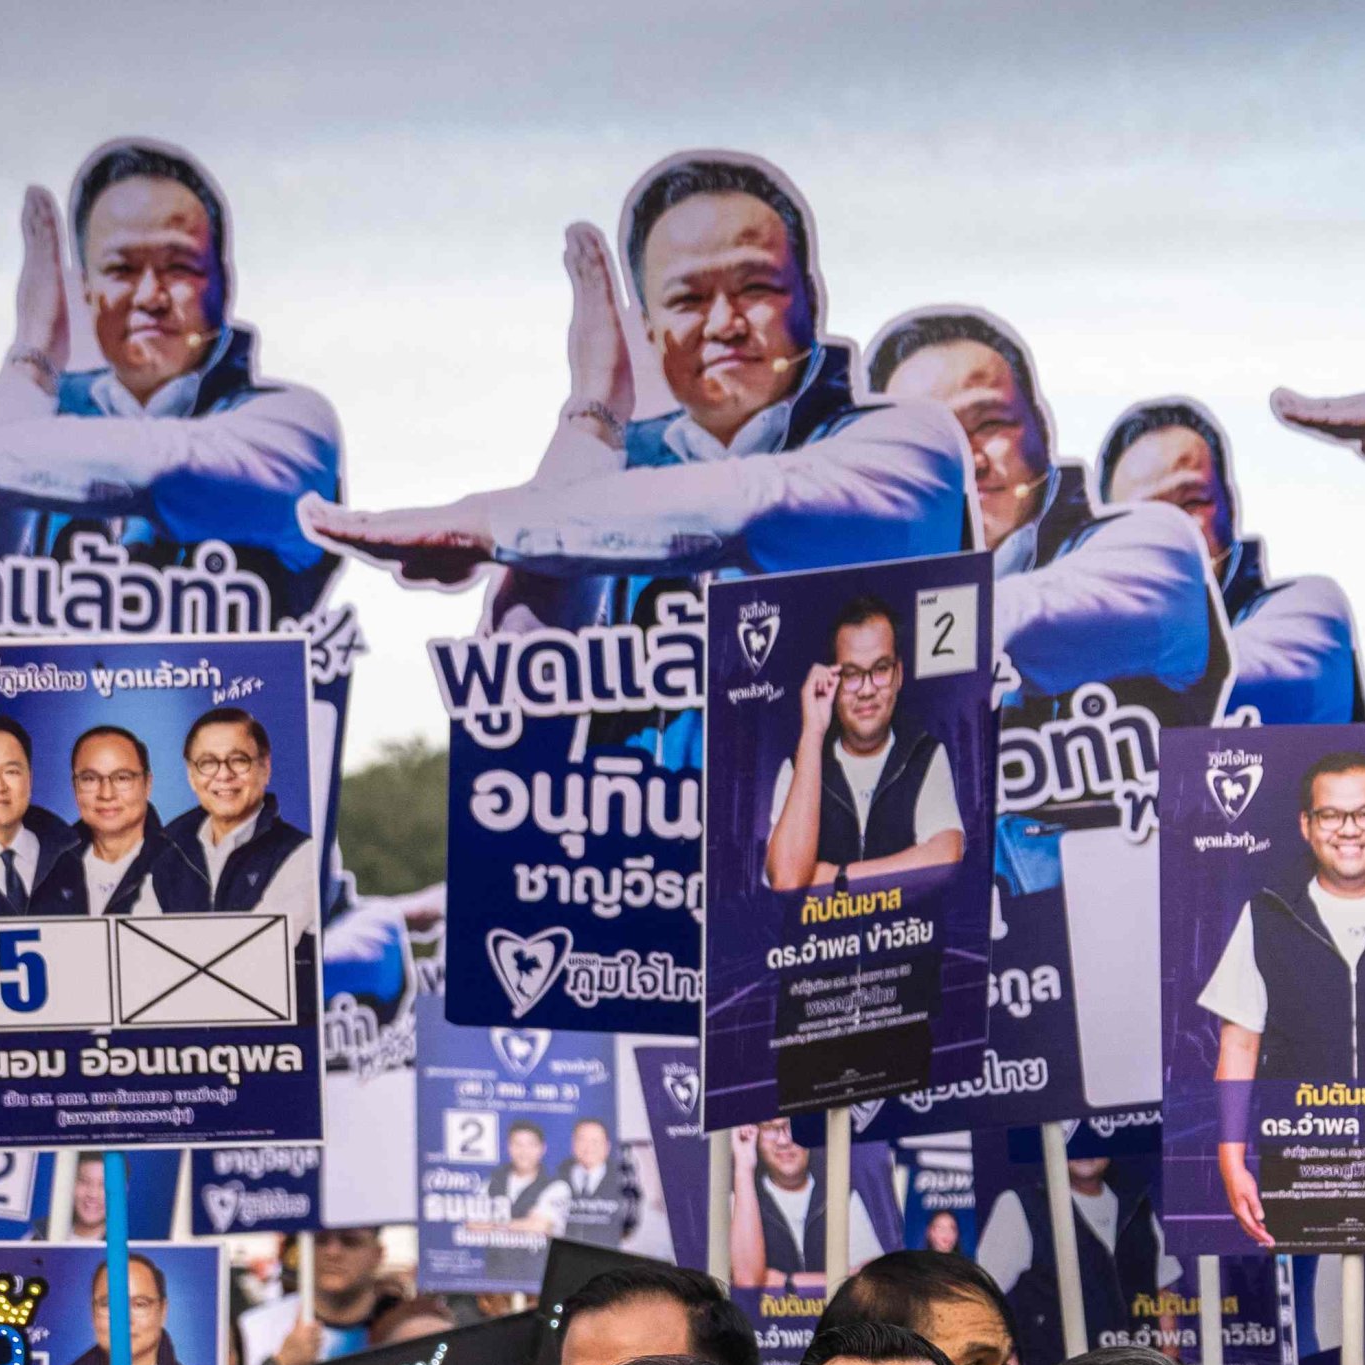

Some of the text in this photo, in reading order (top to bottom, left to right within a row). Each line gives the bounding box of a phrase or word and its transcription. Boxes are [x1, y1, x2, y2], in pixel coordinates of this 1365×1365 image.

[931, 612, 956, 657] 2
[91, 658, 223, 698] พูดแล้วทำ
[470, 757, 704, 858] อนุทิน
[801, 887, 903, 925] กัปตันยาส
[766, 934, 861, 970] ดร.อำพล
[566, 952, 706, 1008] ภูมิใจไท
[79, 1038, 304, 1085] อ่อนเกตุพล
[459, 1117, 484, 1152] 2
[1260, 1112, 1360, 1137] ดร.อำพล
